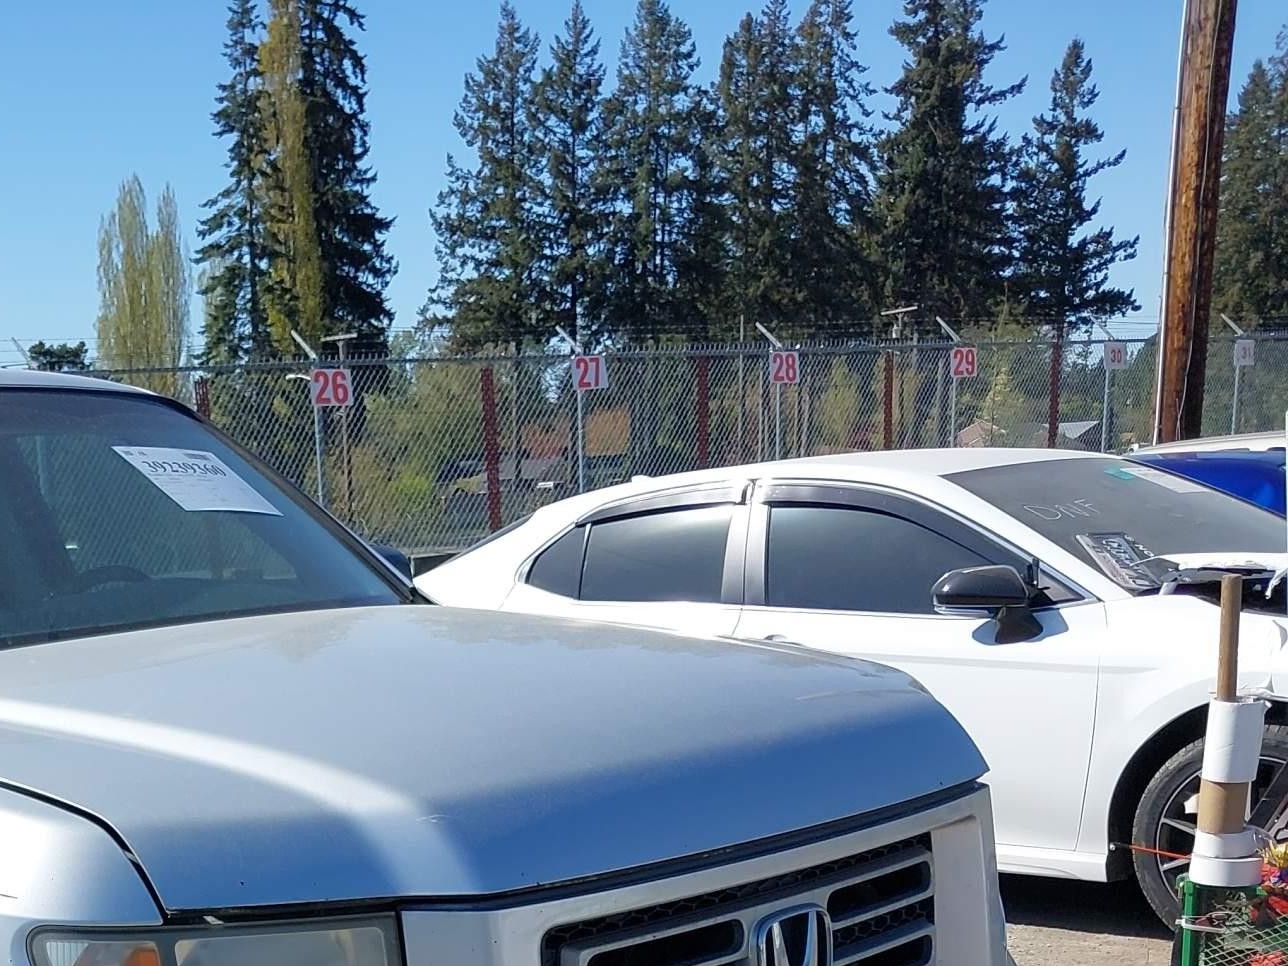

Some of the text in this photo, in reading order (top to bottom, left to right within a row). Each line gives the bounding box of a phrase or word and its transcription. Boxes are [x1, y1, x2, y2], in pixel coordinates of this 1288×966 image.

[772, 353, 797, 382] 28
[953, 349, 976, 376] 29
[1111, 349, 1123, 363] 30
[575, 357, 600, 388] 27
[313, 370, 349, 405] 26
[141, 460, 228, 478] 39239360
